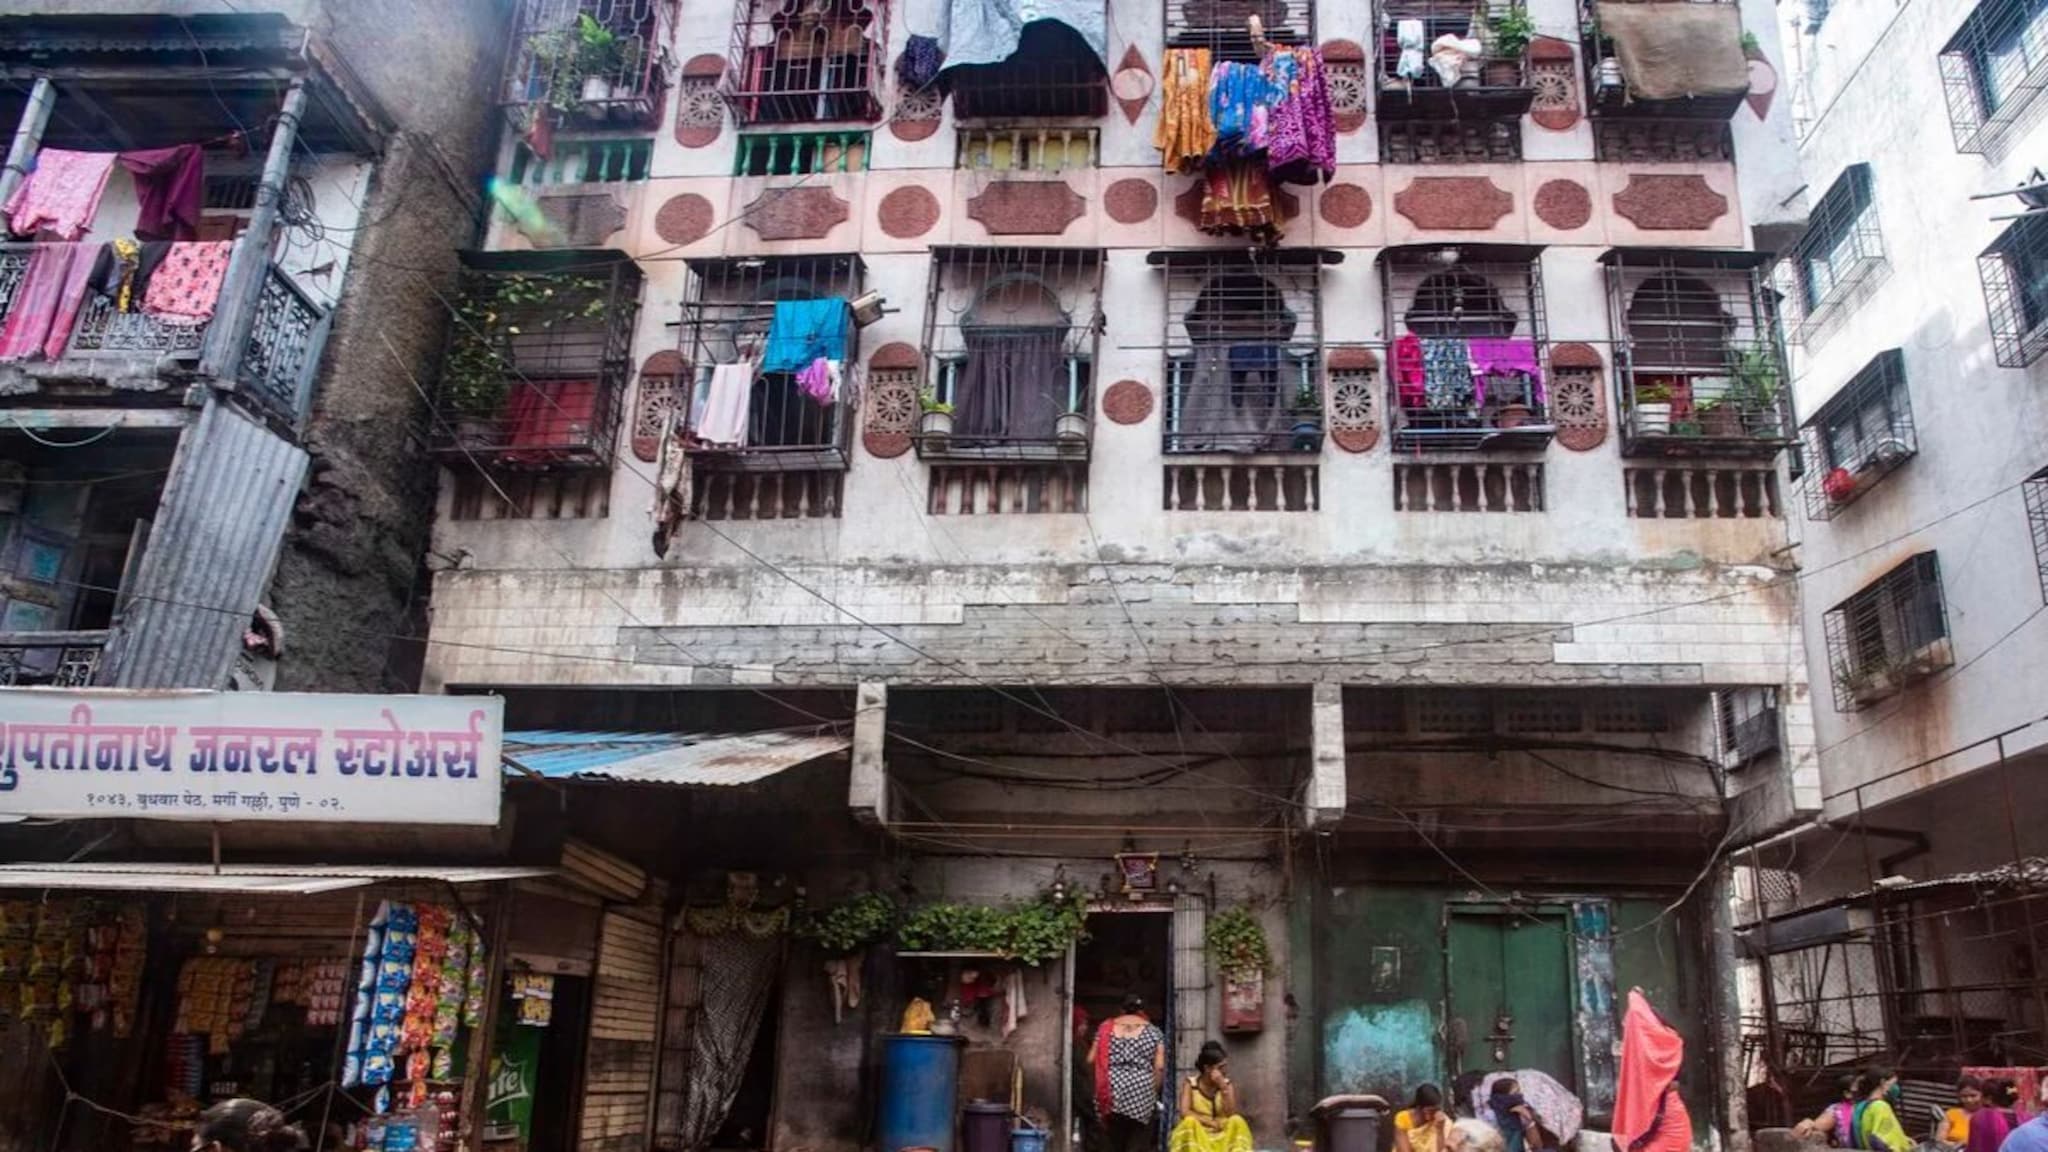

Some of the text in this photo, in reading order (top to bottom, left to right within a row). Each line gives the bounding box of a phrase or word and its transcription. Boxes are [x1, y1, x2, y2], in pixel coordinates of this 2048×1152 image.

[0, 703, 485, 791] शुपतीनाथ जनरल स्टोअर्स
[137, 793, 178, 810] बुधवार
[183, 789, 207, 807] पेठ,
[278, 791, 300, 812] पुणे
[489, 1070, 518, 1101] ite
